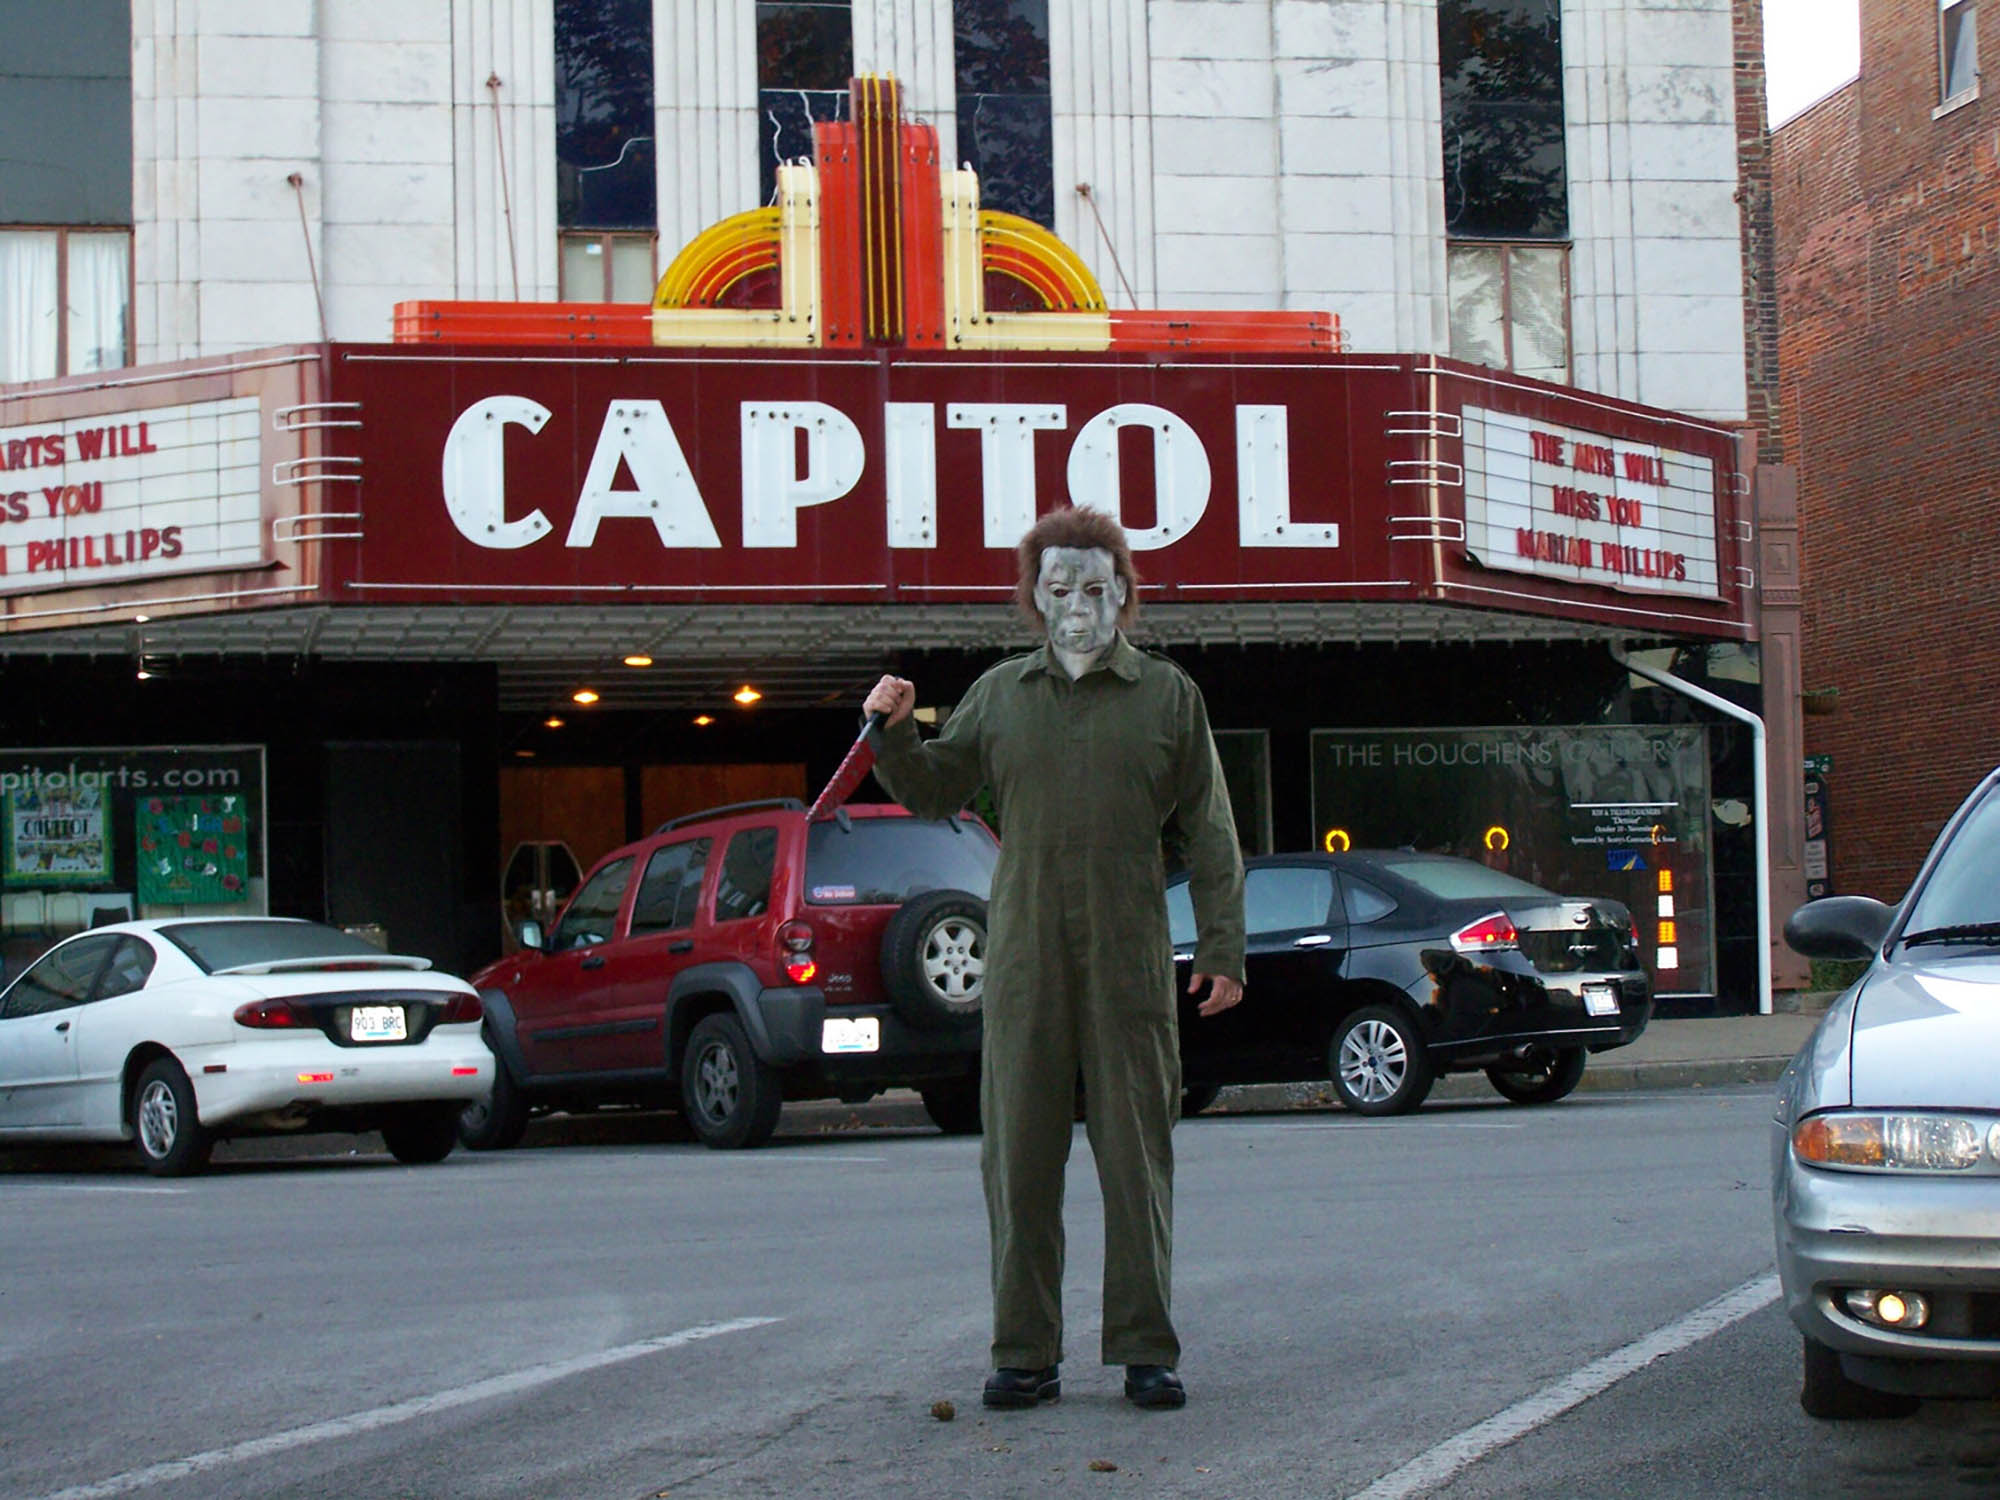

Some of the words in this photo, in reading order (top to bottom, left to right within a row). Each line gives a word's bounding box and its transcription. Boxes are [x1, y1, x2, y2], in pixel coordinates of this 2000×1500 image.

[76, 421, 157, 461] WILL
[1529, 430, 1565, 467] THE
[1573, 441, 1615, 478] ARTS
[1624, 451, 1669, 487] WILL
[440, 394, 1340, 552] CAPITOL
[41, 481, 103, 518] YOU
[1553, 484, 1601, 521] MISS
[1606, 496, 1643, 528] YOU
[27, 526, 182, 573] PHILLIPS
[1516, 527, 1592, 568] MARIAN
[1602, 541, 1686, 582] PHILLIPS
[1330, 743, 1382, 767] THE
[1393, 742, 1553, 766] HOUCHENS
[354, 1016, 375, 1030] 903
